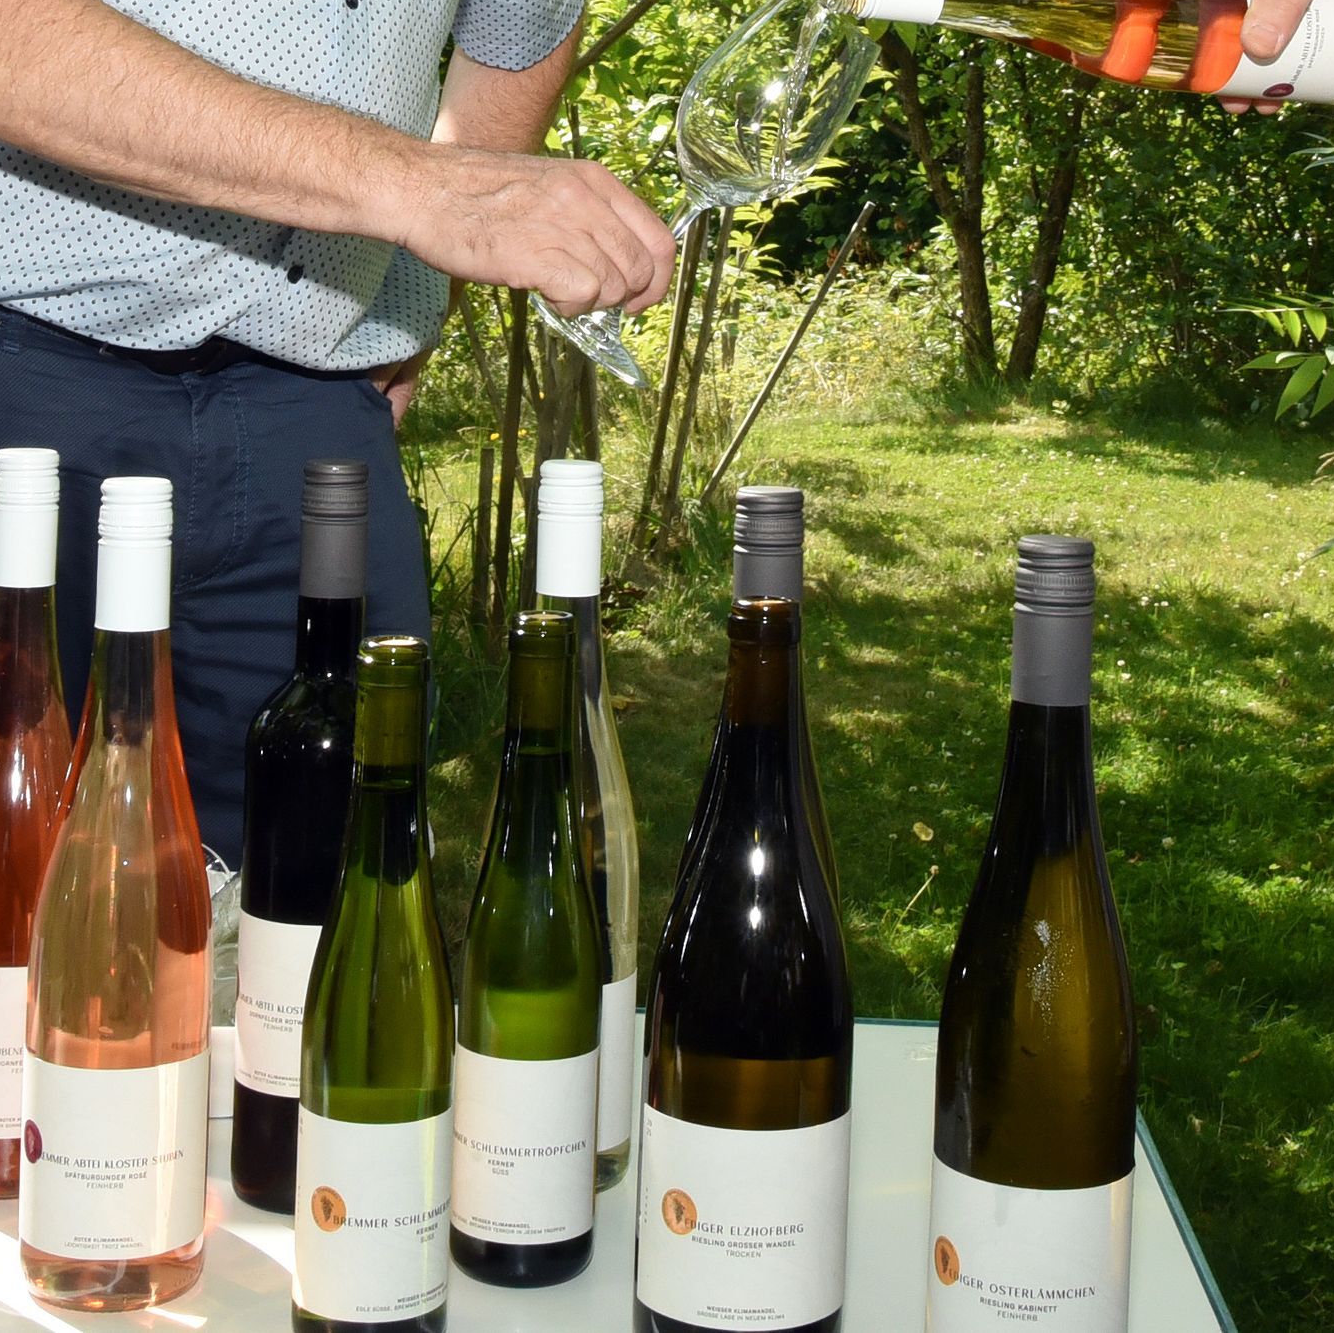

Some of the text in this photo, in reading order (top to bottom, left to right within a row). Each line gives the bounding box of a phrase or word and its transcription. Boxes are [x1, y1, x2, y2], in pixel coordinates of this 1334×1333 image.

[471, 1139, 587, 1157] SCHLEMMERTRÖPFCHEN
[73, 1160, 101, 1168] ABTEI
[105, 1158, 148, 1169] KLOSTER
[152, 1149, 184, 1165] STUBEN
[488, 1159, 515, 1168] KERNER
[64, 1171, 126, 1181] SPÄTBURGUNDER
[492, 1167, 509, 1176] SÜSS
[333, 1217, 388, 1228] BREMMER
[685, 1218, 804, 1237] EDIGER ELZHOFBERG
[691, 1235, 796, 1249] RIESLING GROSSER WANDEL
[726, 1249, 761, 1258] TROCKEN
[949, 1268, 1095, 1299] EDIGER OSTERLÄMMCHEN
[980, 1297, 1057, 1313] RIESLING KABINETT
[997, 1310, 1038, 1322] FEINHERB
